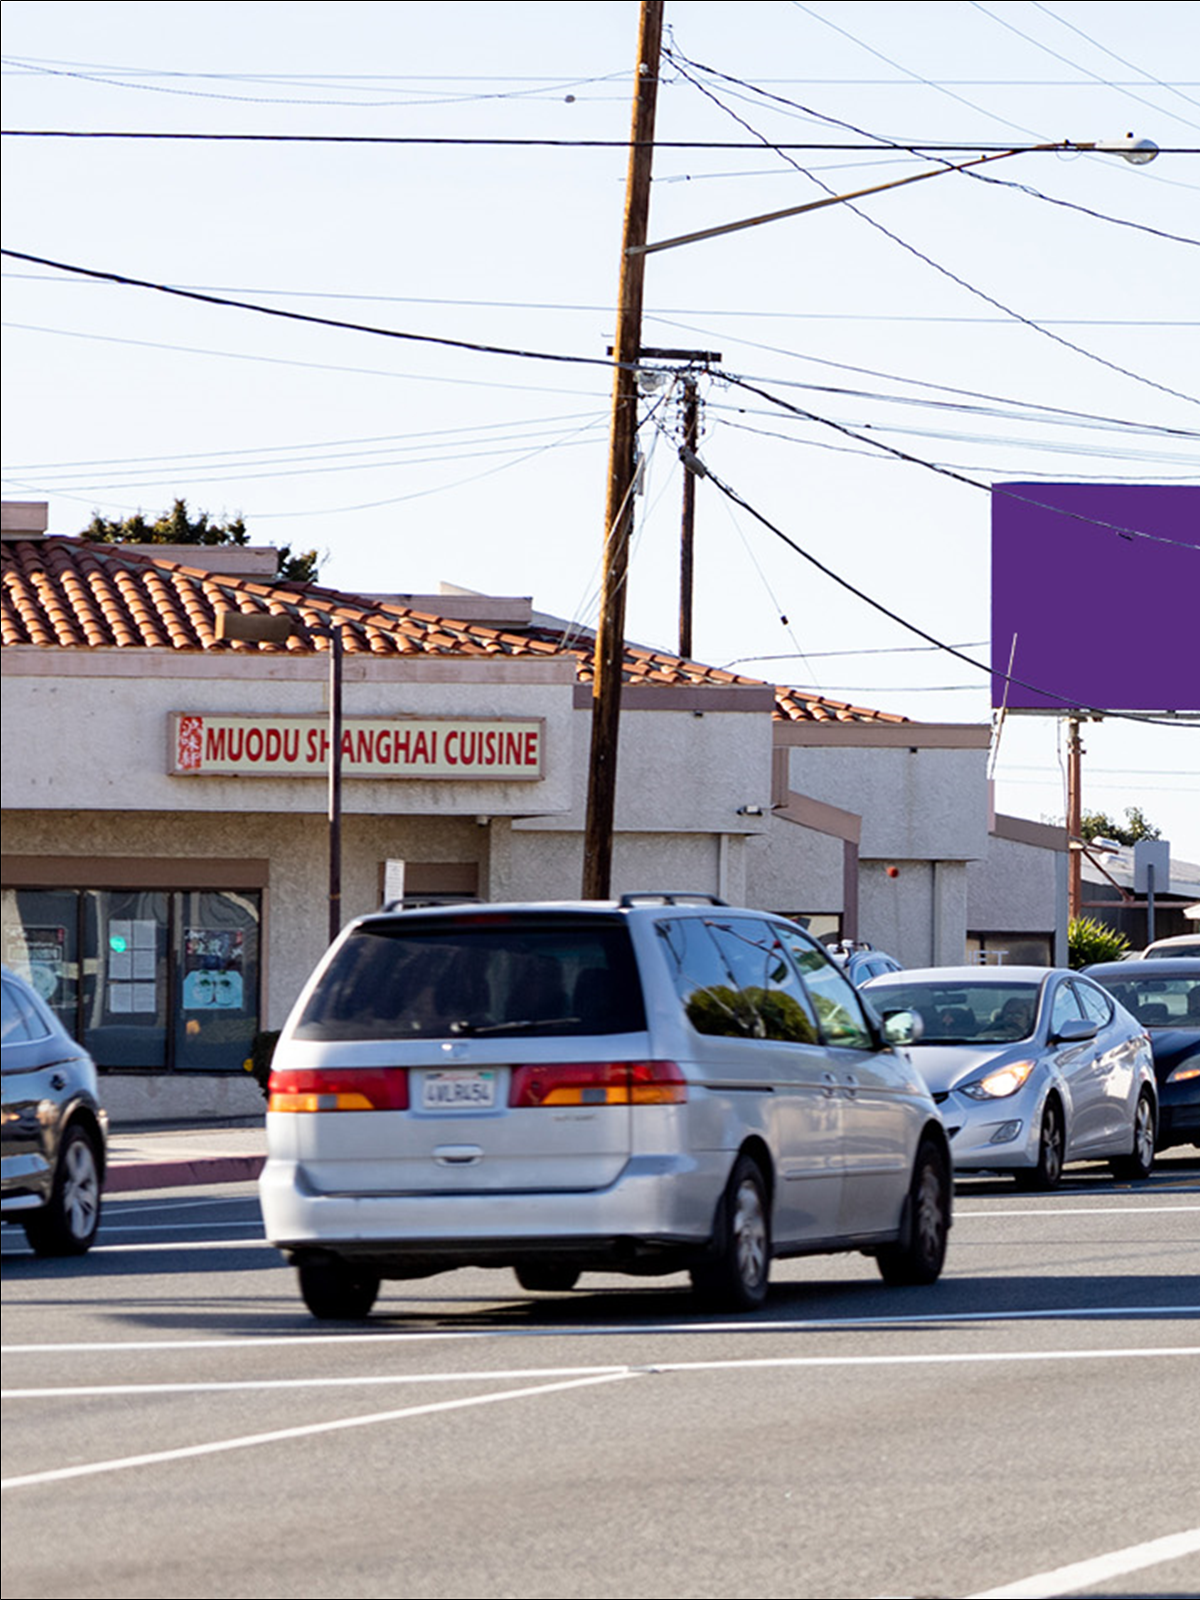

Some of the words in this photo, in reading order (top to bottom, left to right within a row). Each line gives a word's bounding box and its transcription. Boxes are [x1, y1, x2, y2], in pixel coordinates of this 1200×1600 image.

[205, 727, 300, 763] MUODU
[306, 728, 437, 765] SHANGHAI
[444, 731, 538, 766] CUISINE
